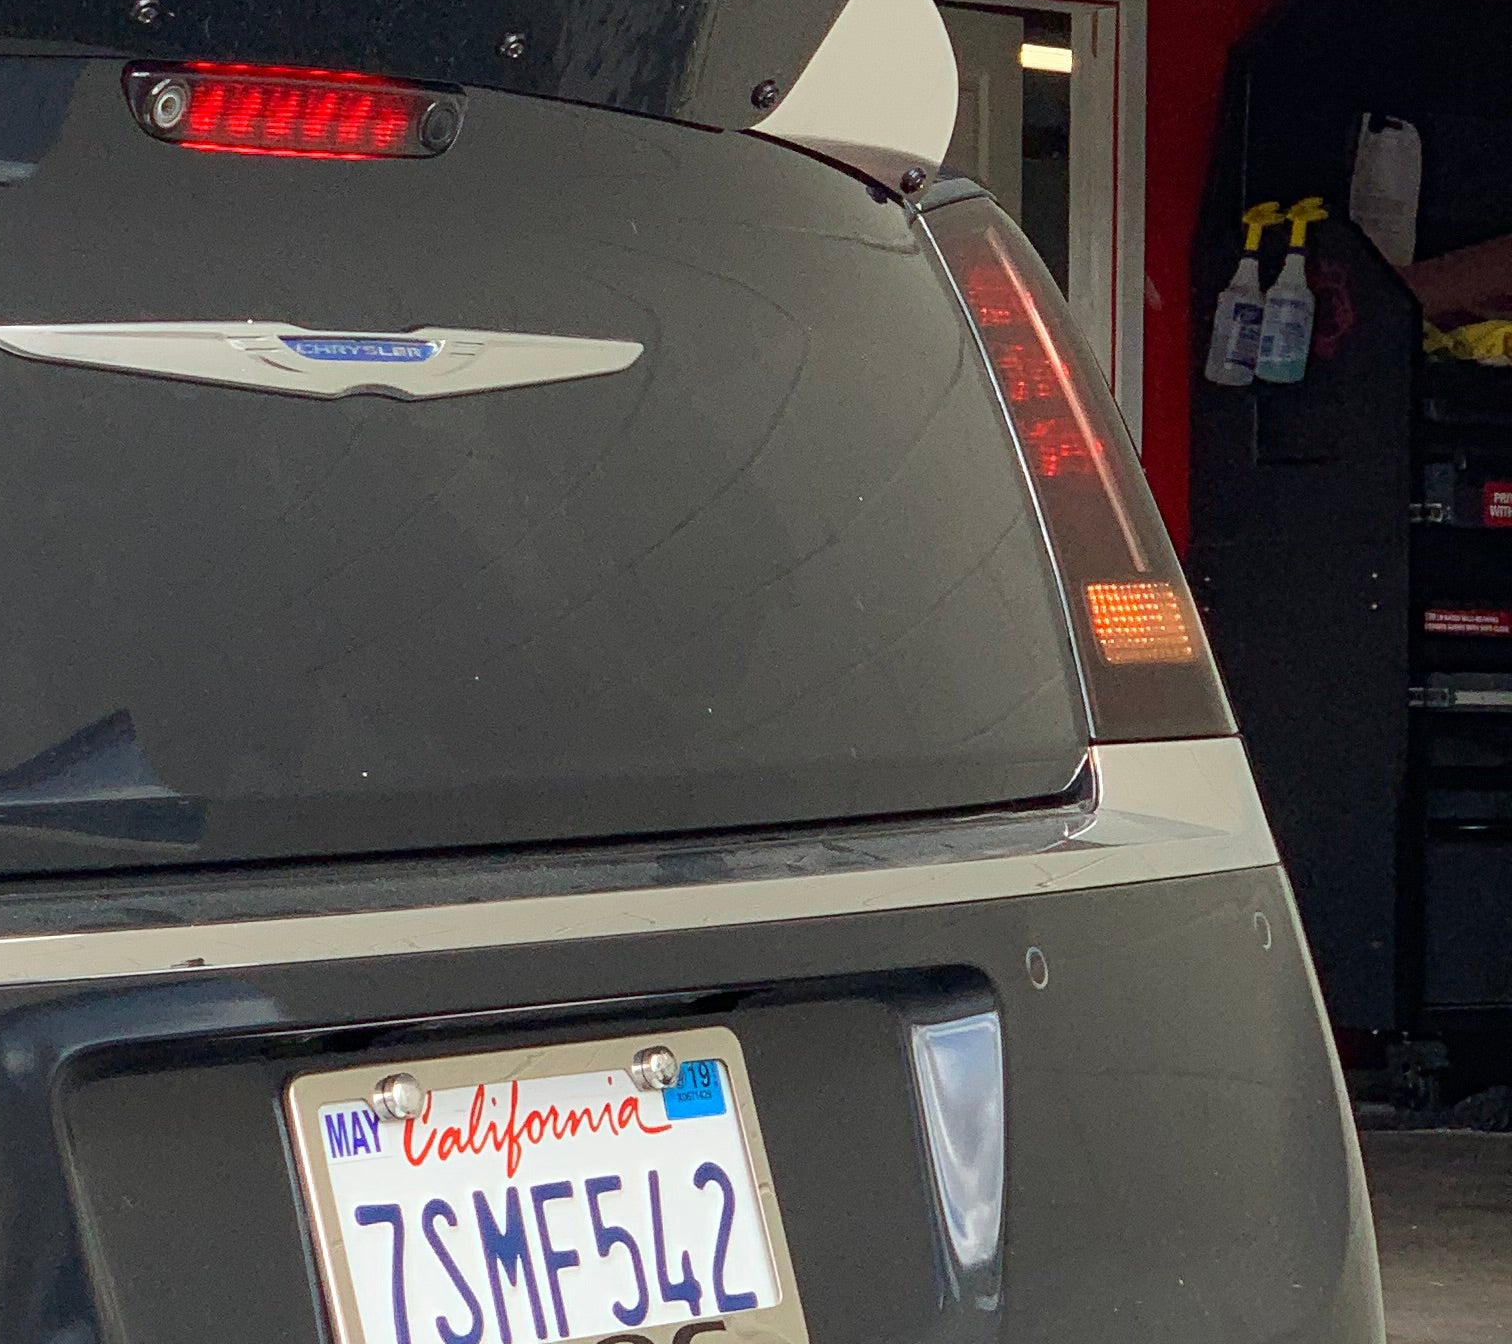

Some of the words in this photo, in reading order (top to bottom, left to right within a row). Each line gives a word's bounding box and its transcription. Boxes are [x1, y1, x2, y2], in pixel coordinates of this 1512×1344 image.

[295, 342, 422, 358] CHRYSLER
[688, 1061, 711, 1088] 19
[325, 1108, 382, 1159] MAY
[402, 1076, 673, 1179] California
